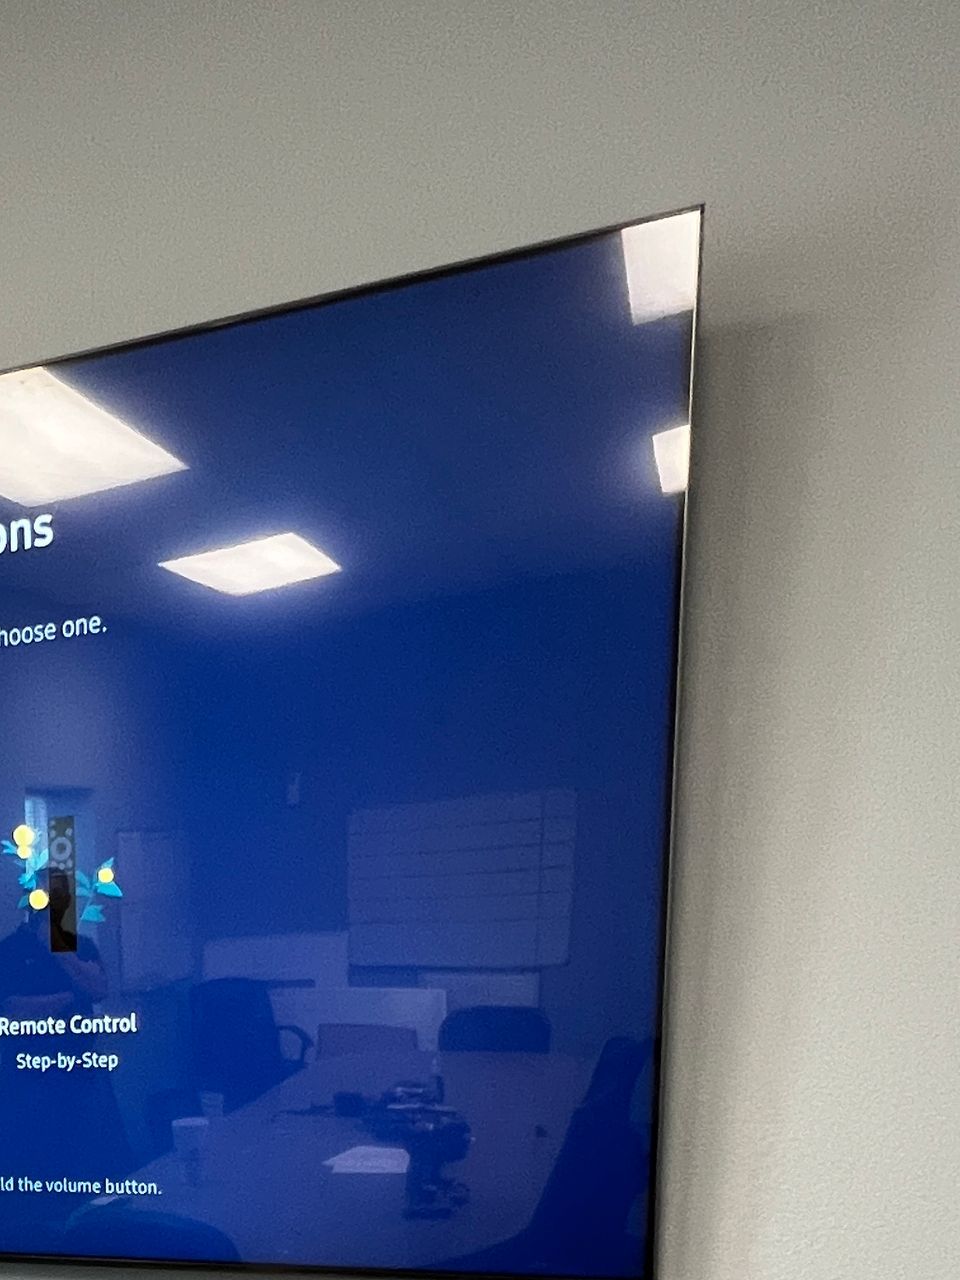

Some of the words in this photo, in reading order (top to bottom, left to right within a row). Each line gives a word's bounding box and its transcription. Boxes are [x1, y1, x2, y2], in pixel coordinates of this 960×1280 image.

[62, 614, 108, 637] one.
[69, 1012, 138, 1035] Control
[16, 1052, 119, 1072] Step-by-Step
[17, 1177, 43, 1194] the
[45, 1178, 101, 1195] volume
[106, 1178, 162, 1195] button.
